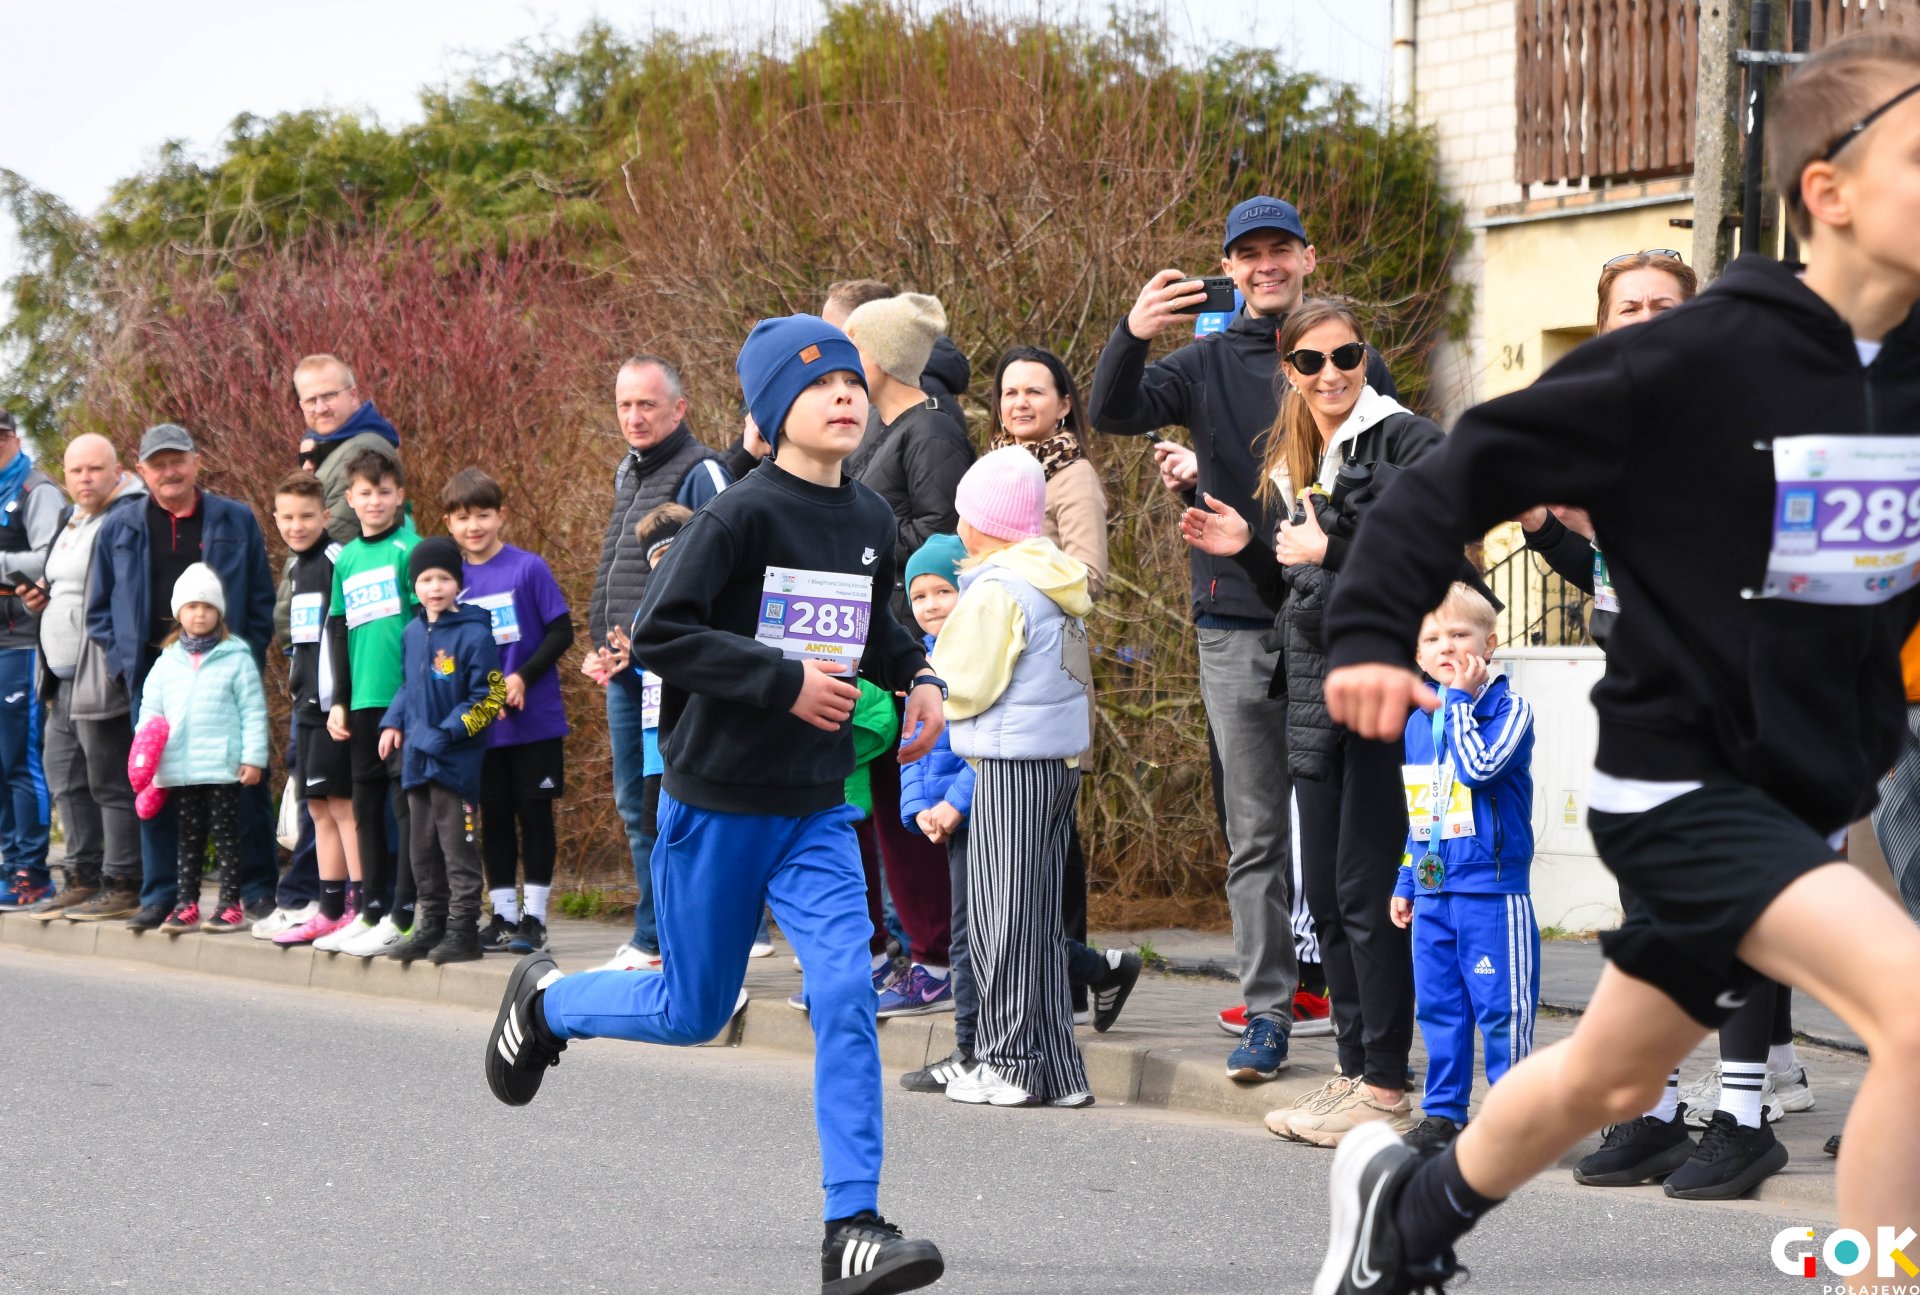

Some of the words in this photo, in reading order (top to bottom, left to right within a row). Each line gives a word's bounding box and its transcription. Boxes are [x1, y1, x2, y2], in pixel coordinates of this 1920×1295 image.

[1503, 342, 1524, 370] 34
[350, 585, 382, 608] 328
[788, 601, 855, 638] 283
[805, 643, 843, 654] ANTONI
